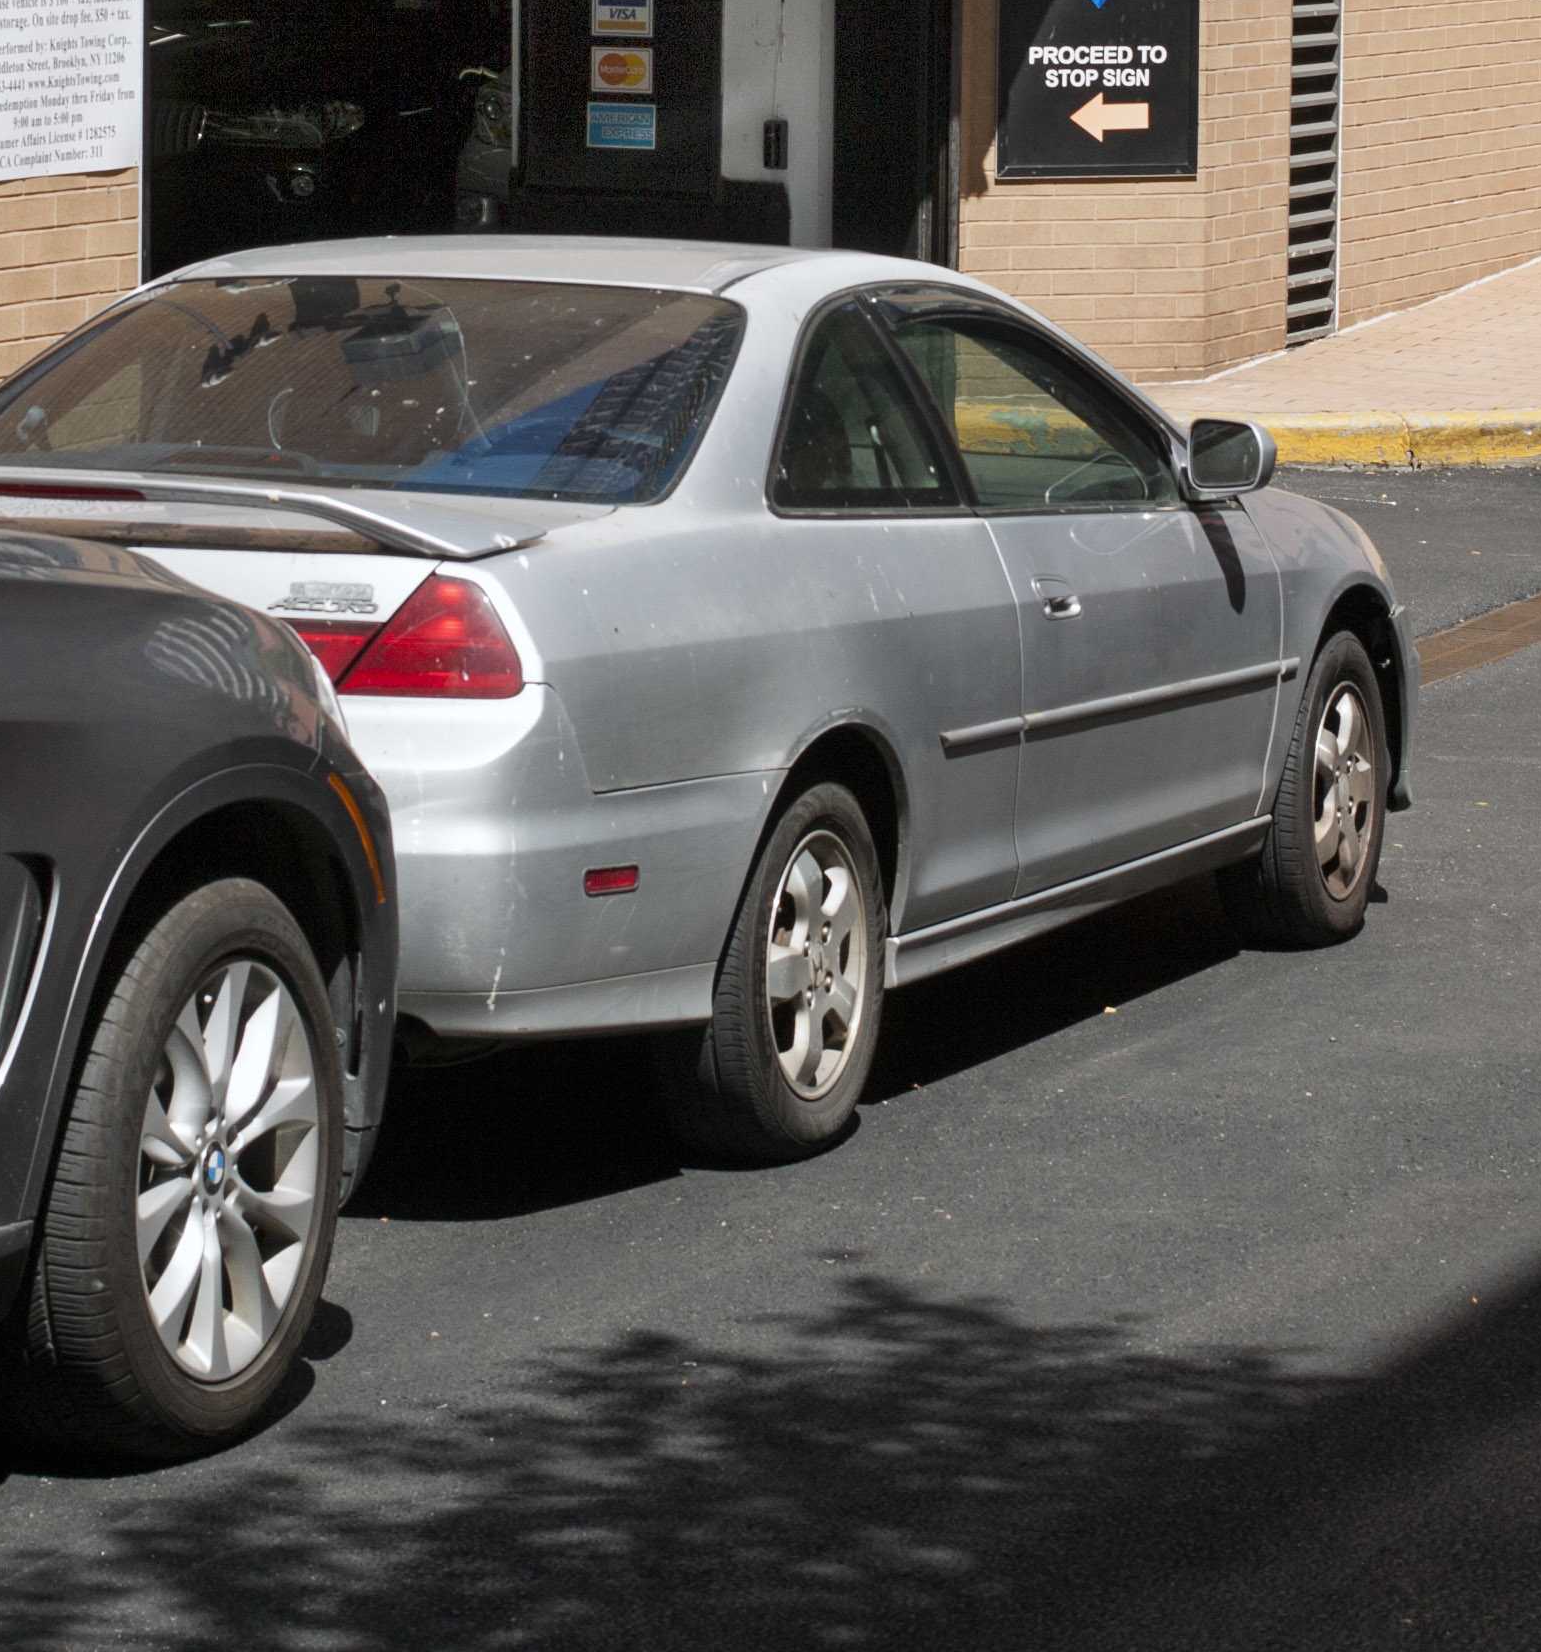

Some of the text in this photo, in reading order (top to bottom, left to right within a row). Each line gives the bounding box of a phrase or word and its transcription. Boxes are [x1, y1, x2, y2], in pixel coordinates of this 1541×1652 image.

[32, 13, 43, 27] On
[61, 10, 78, 29] drop
[608, 7, 637, 21] VISA
[50, 38, 78, 53] Knights
[81, 36, 106, 48] Towing
[53, 55, 87, 72] Brooklyn,
[90, 53, 101, 66] NY
[1029, 45, 1167, 65] PROCEED TO
[1045, 68, 1150, 88] STOP SIGN
[41, 94, 69, 109] Monday
[90, 90, 115, 103] Friday
[118, 88, 135, 100] from
[31, 116, 42, 126] am
[44, 114, 52, 125] to
[72, 112, 82, 127] pm
[21, 133, 46, 148] Affairs
[48, 130, 76, 145] License
[14, 151, 52, 169] Complaint
